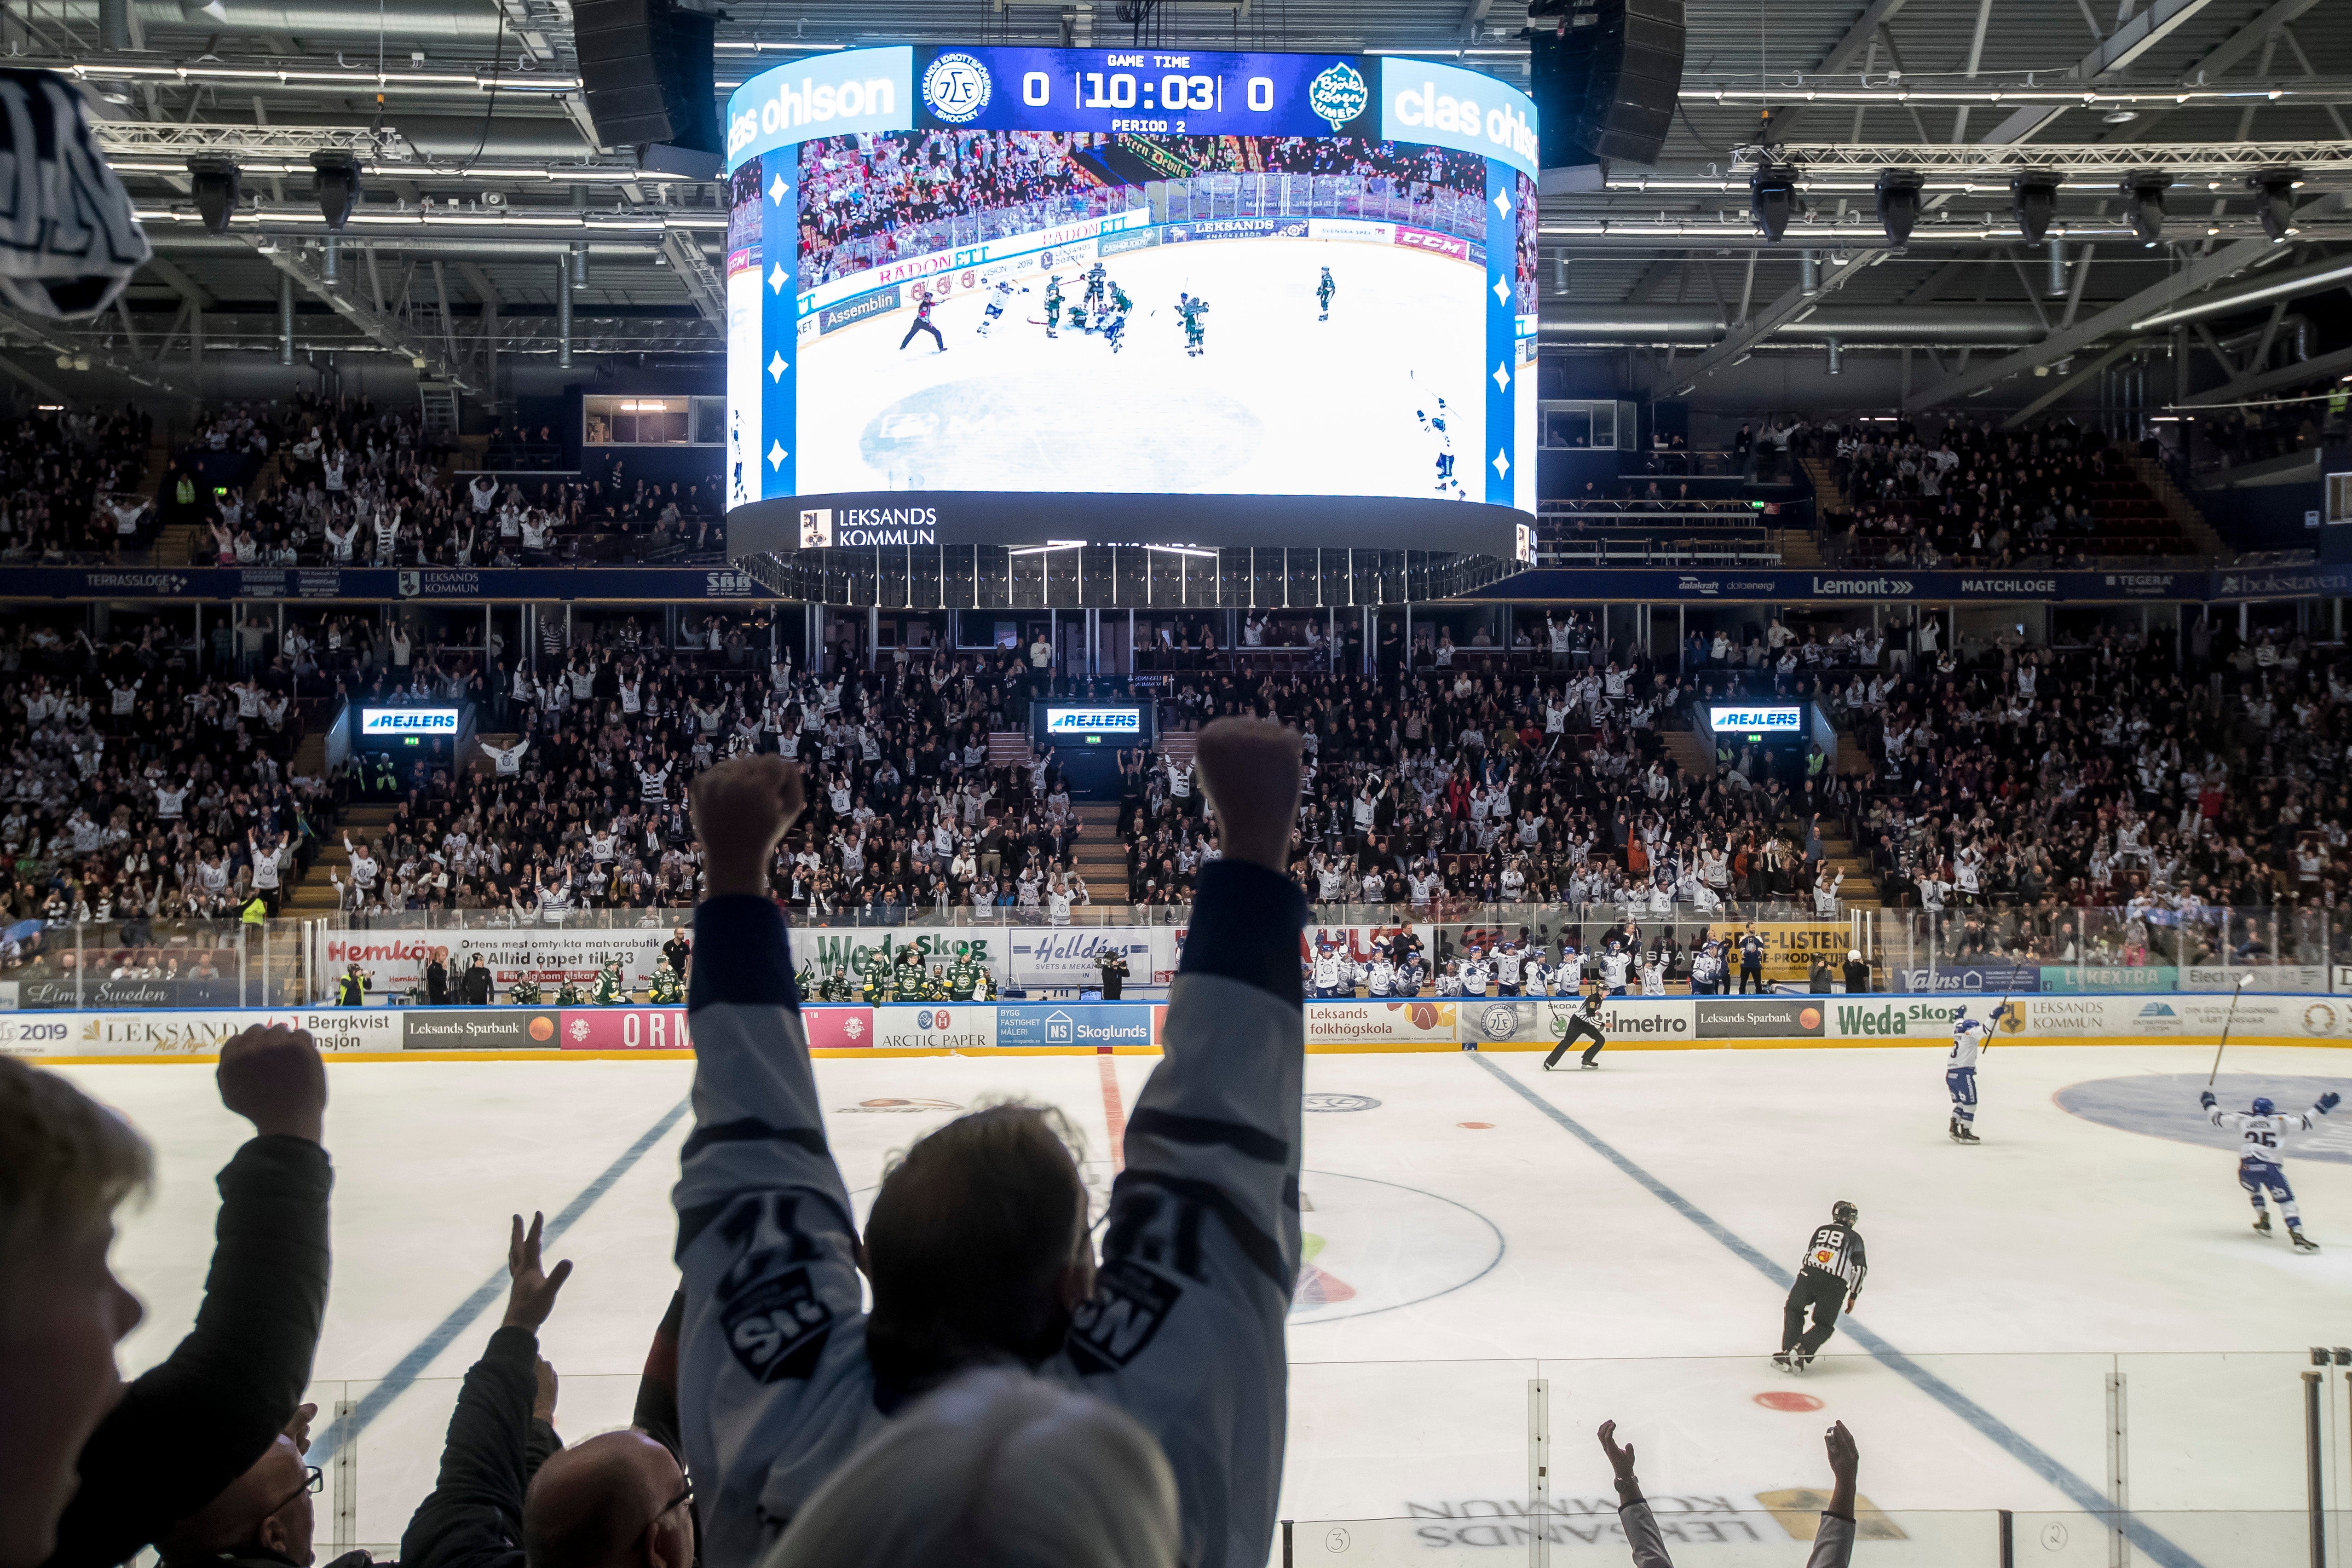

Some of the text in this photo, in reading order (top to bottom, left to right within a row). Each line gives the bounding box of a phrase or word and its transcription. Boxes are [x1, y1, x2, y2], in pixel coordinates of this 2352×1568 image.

[1107, 55, 1190, 68] GAME TIME
[922, 60, 941, 106] LEKSANDS
[940, 53, 992, 107] IDROTTSFÖRENING
[1023, 72, 1049, 106] 0
[1085, 73, 1214, 110] 10:03
[1247, 77, 1274, 111] 0
[762, 77, 894, 135] ohlson
[1316, 102, 1358, 118] UMEÅ
[1395, 81, 1481, 137] clas
[935, 109, 979, 123] ISHOCKEY
[1112, 119, 1186, 132] PERIOD 2
[1151, 149, 1187, 178] Devils
[1195, 220, 1274, 233] LEKSANDS
[1402, 231, 1461, 254] CCM
[879, 246, 990, 286] RADONETT
[827, 294, 893, 327] Assemblin
[840, 508, 937, 526] LEKSANDS
[840, 530, 934, 546] KOMMUN
[87, 575, 169, 587] TERRASSLOGE
[425, 572, 478, 582] LEKSANDS
[707, 572, 752, 592] SBB
[1813, 576, 1888, 594] Lemont
[2120, 576, 2171, 585] TEGERA
[425, 583, 478, 593] KOMMUN
[1962, 580, 2056, 592] MATCHLOGE
[380, 716, 455, 727] REJLERS
[1064, 715, 1137, 726] REJLERS
[1727, 714, 1797, 725] REJLERS
[462, 940, 498, 949] Ortens
[502, 940, 528, 948] mest
[585, 939, 660, 949] matvarubutik
[1764, 931, 1850, 949] E-LISTEN
[488, 952, 530, 964] Alltid
[536, 952, 583, 968] öppet
[563, 972, 595, 980] älskar
[95, 983, 167, 1003] Sweden
[1310, 1008, 1368, 1019] Leksands
[2033, 1001, 2104, 1014] LEKSANDS
[309, 1015, 389, 1032] Bergkvist
[1490, 1004, 1518, 1032] IDROTTSFÖRENING
[1701, 1013, 1792, 1026] Leksands Sparbank
[1838, 1004, 1906, 1035] Weda
[2033, 1017, 2103, 1029] KOMMUN
[20, 1024, 68, 1040] 2019
[410, 1022, 519, 1037] Leksands Sparbank
[1001, 1027, 1028, 1036] MÅLERI
[1051, 1024, 1068, 1039] NS
[1077, 1024, 1147, 1041] Skoglunds
[1310, 1022, 1393, 1038] folkhögskola
[1488, 1033, 1511, 1042] ISHOCKEY
[312, 1033, 361, 1050] nsjön
[882, 1034, 986, 1047] ARCTIC PAPER
[1816, 1229, 1845, 1247] 98
